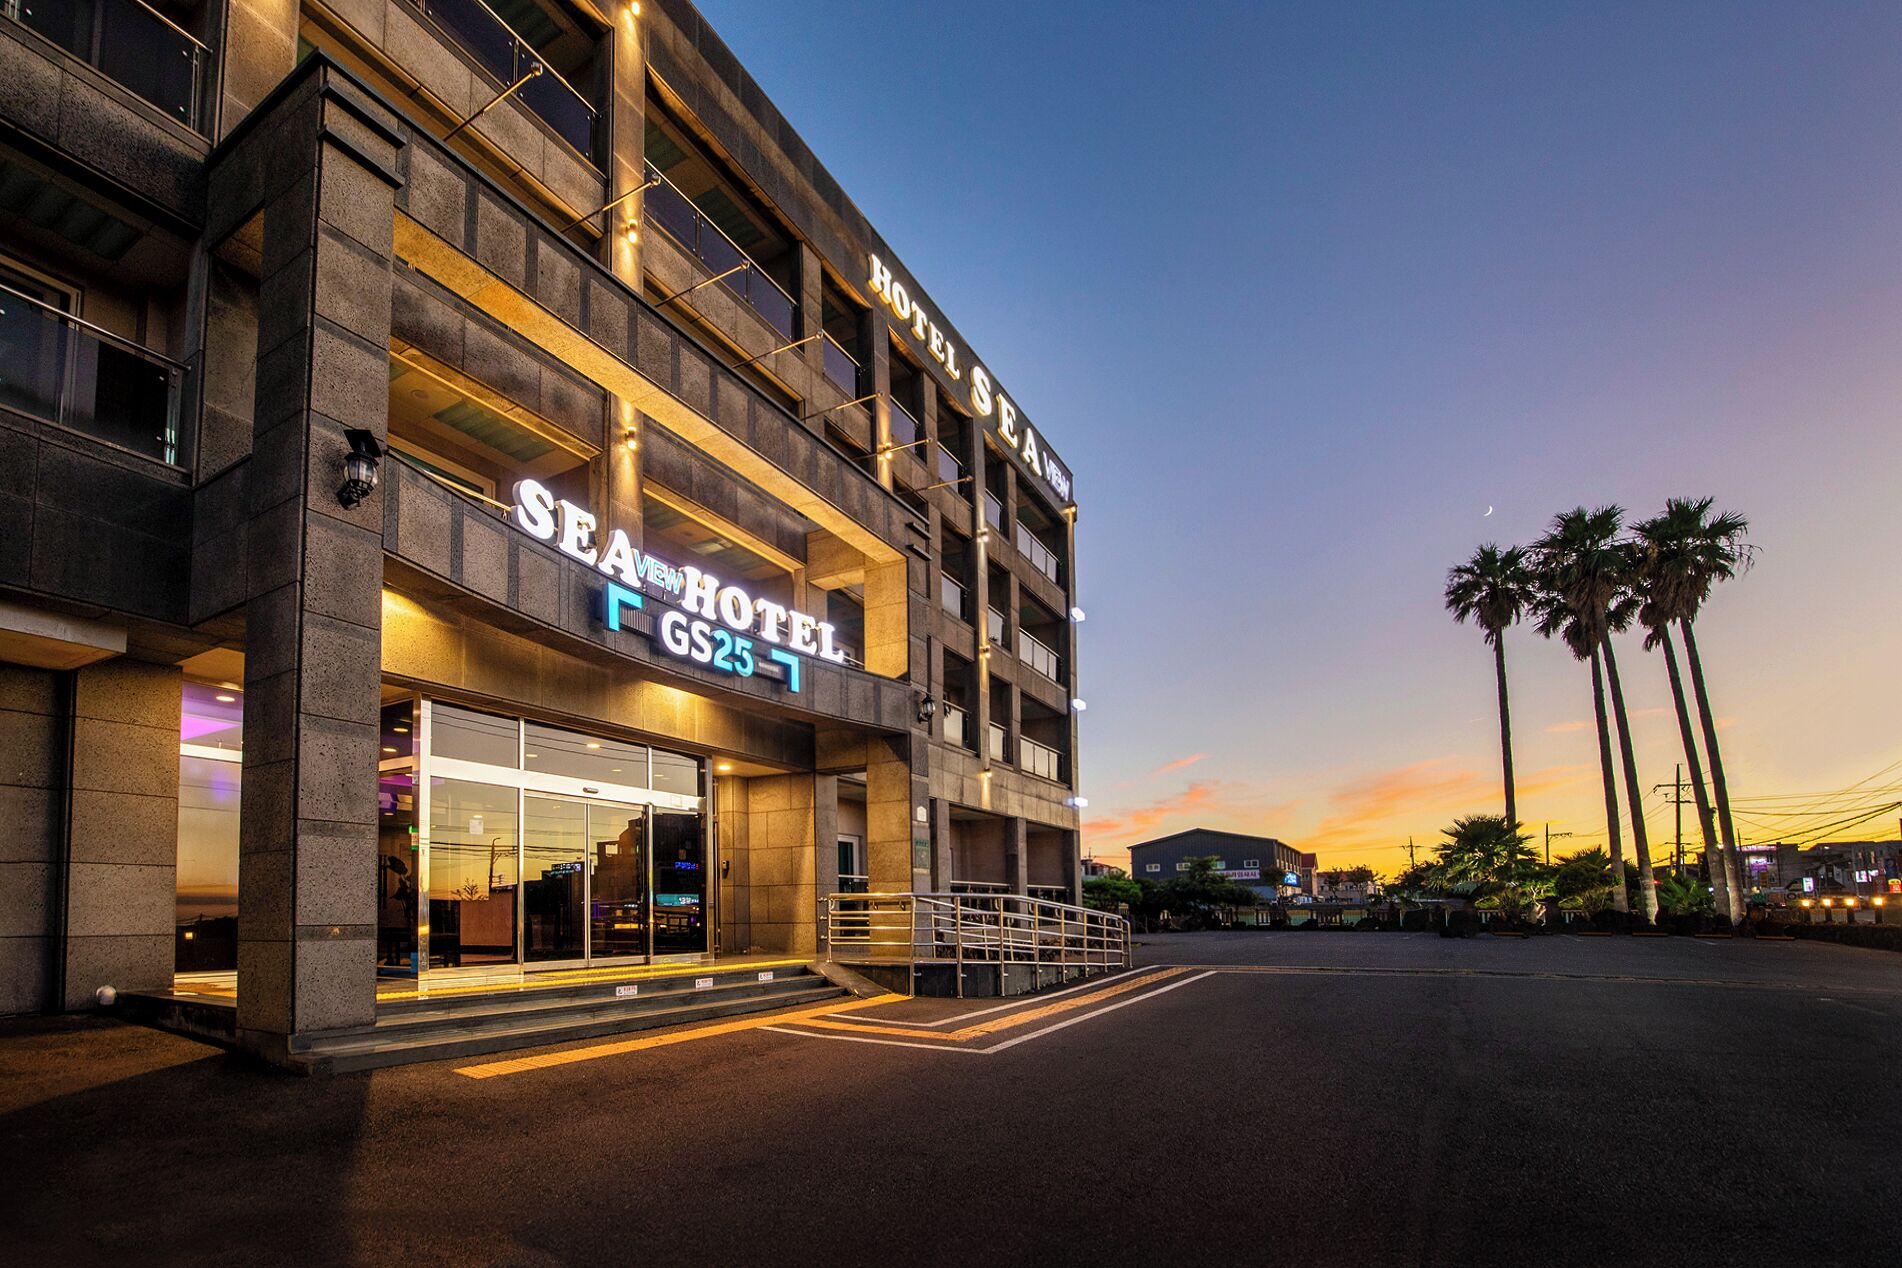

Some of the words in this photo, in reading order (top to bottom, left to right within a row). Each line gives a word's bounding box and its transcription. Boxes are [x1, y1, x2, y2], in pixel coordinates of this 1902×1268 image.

[868, 253, 960, 381] HOTEL
[969, 365, 1042, 477] SEA
[511, 478, 643, 588] SEA
[632, 548, 683, 595] VIEW
[679, 565, 846, 664] HOTEL
[658, 610, 755, 678] GS25
